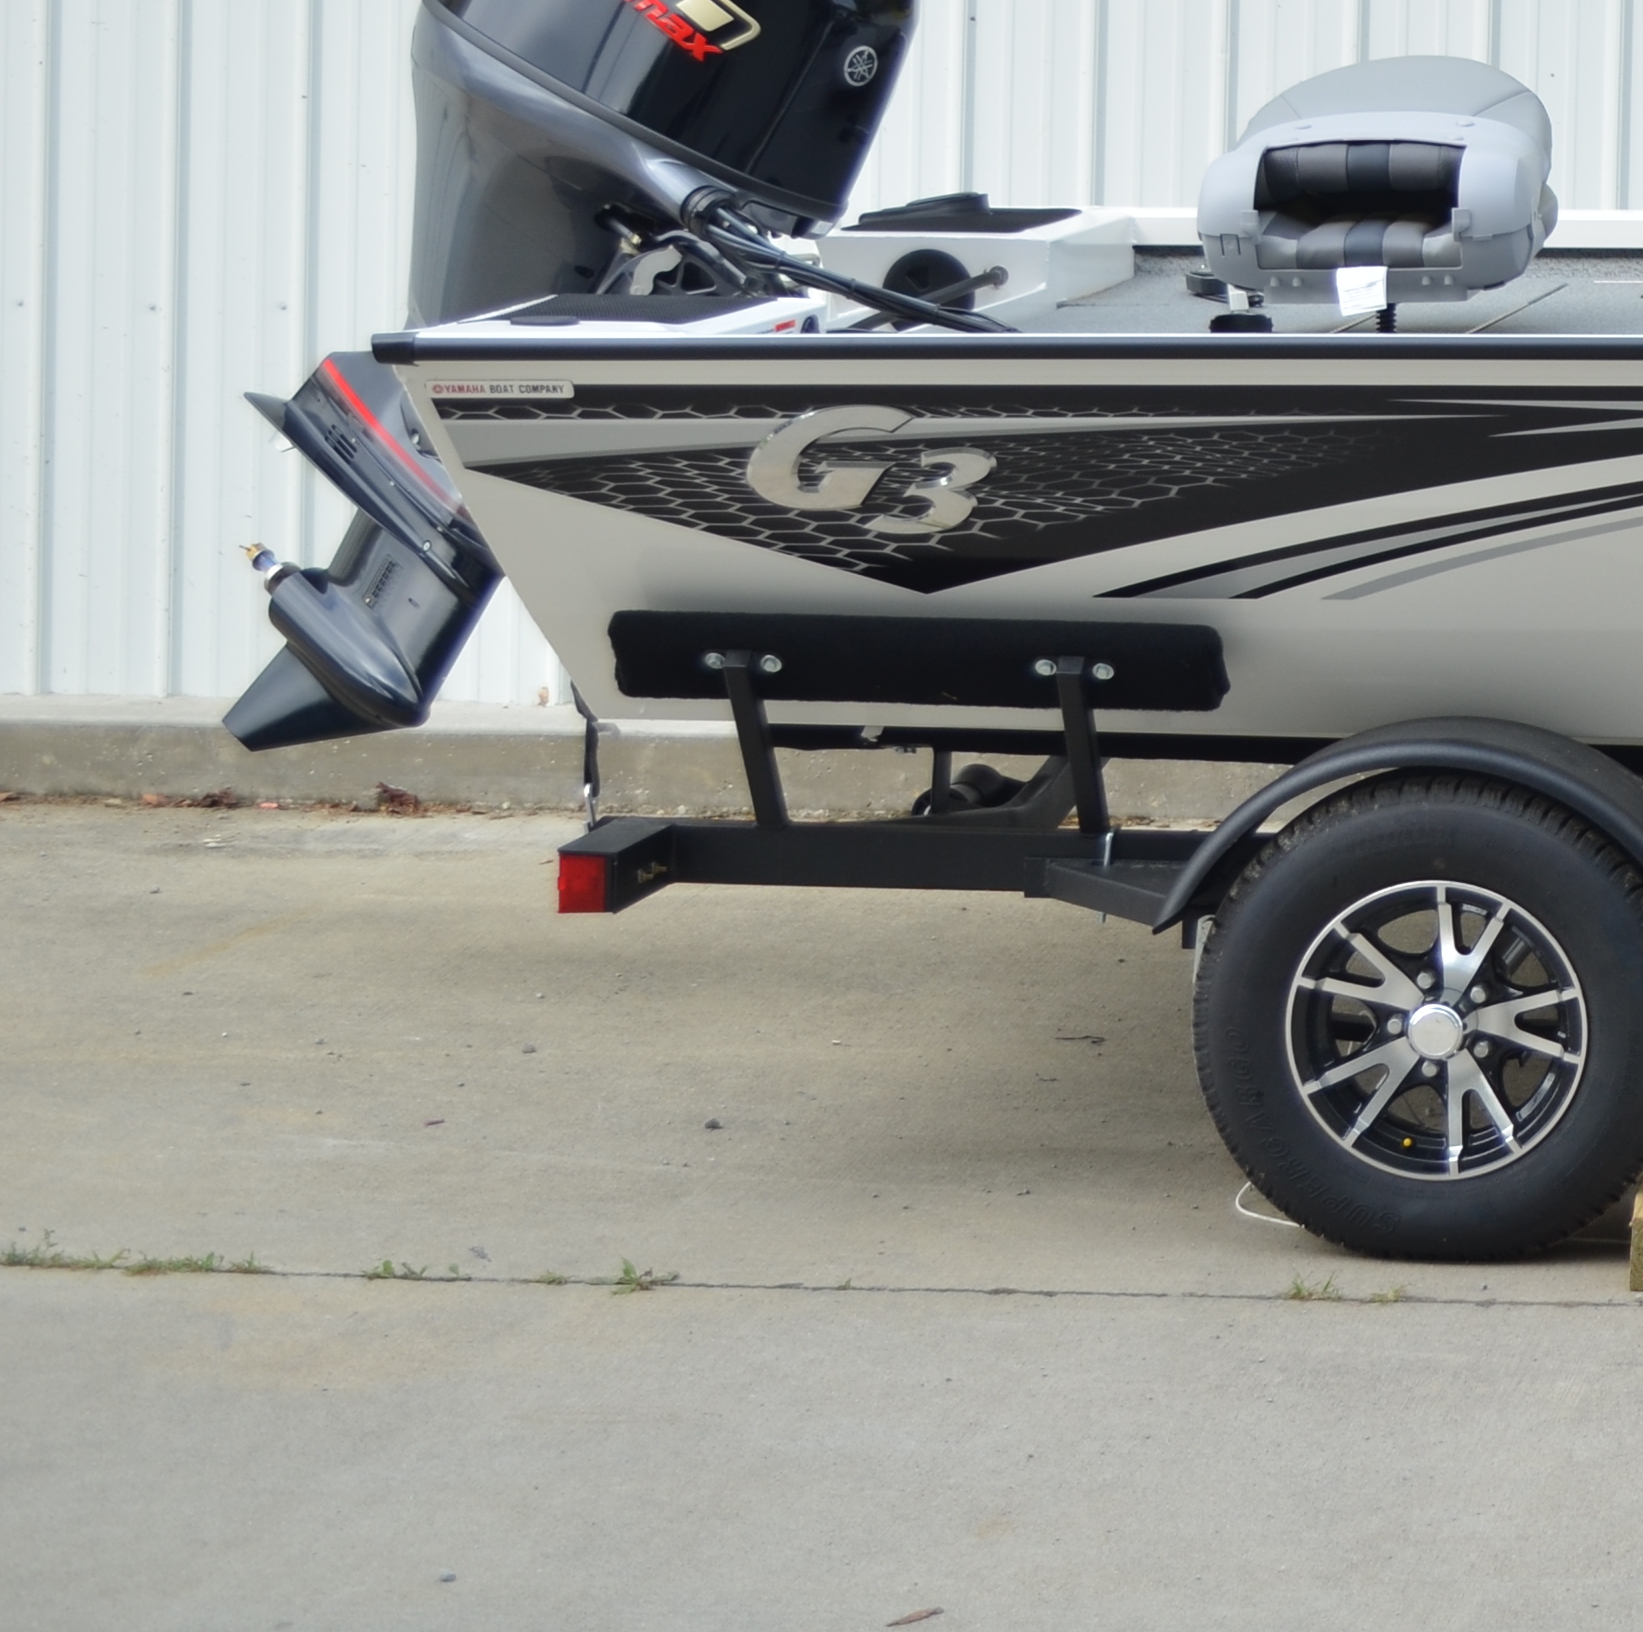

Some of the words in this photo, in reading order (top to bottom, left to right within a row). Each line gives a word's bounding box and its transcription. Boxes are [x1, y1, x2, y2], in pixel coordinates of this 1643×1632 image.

[445, 384, 486, 394] YAMAHA
[490, 384, 514, 394] BOAT
[519, 384, 565, 394] COMPANY
[747, 404, 997, 535] G3
